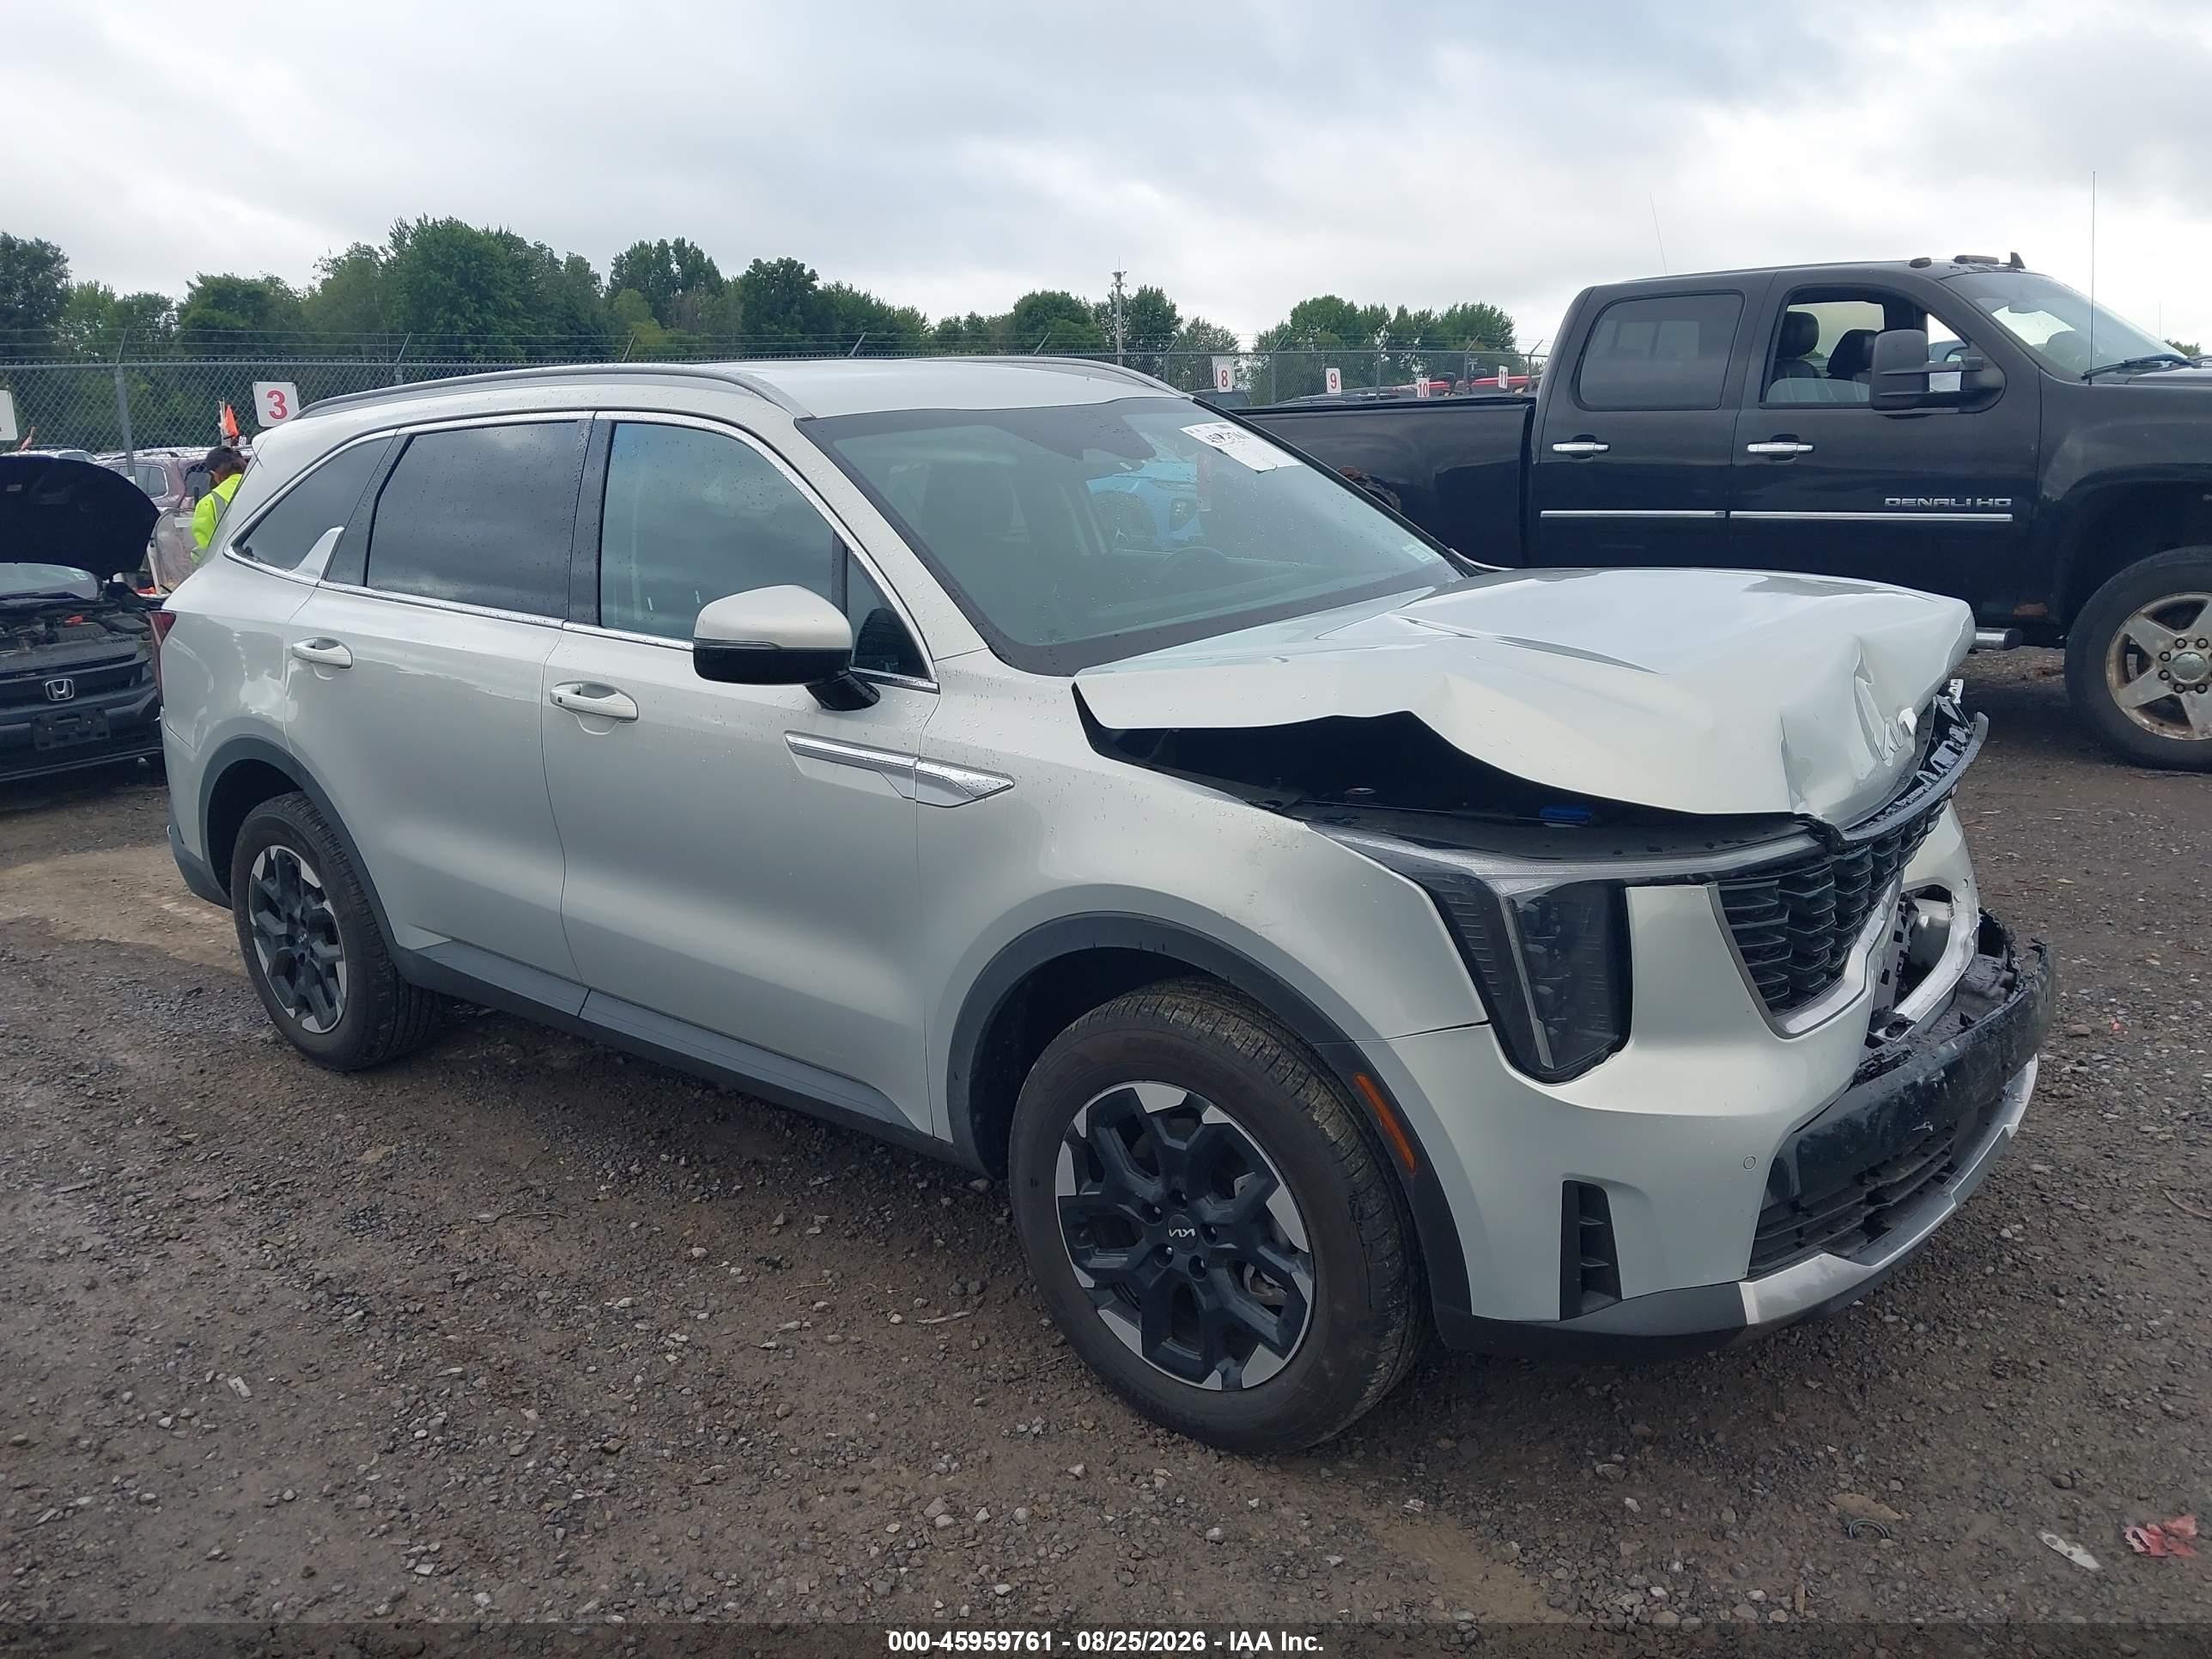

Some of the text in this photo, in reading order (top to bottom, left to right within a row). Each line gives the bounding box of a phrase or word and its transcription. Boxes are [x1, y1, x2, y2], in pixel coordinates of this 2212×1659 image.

[1221, 369, 1229, 388] 8
[1330, 373, 1337, 390] 9
[1499, 371, 1507, 386] 11
[1419, 383, 1428, 397] 10
[266, 389, 288, 420] 3
[1885, 497, 2012, 507] DENALI HD
